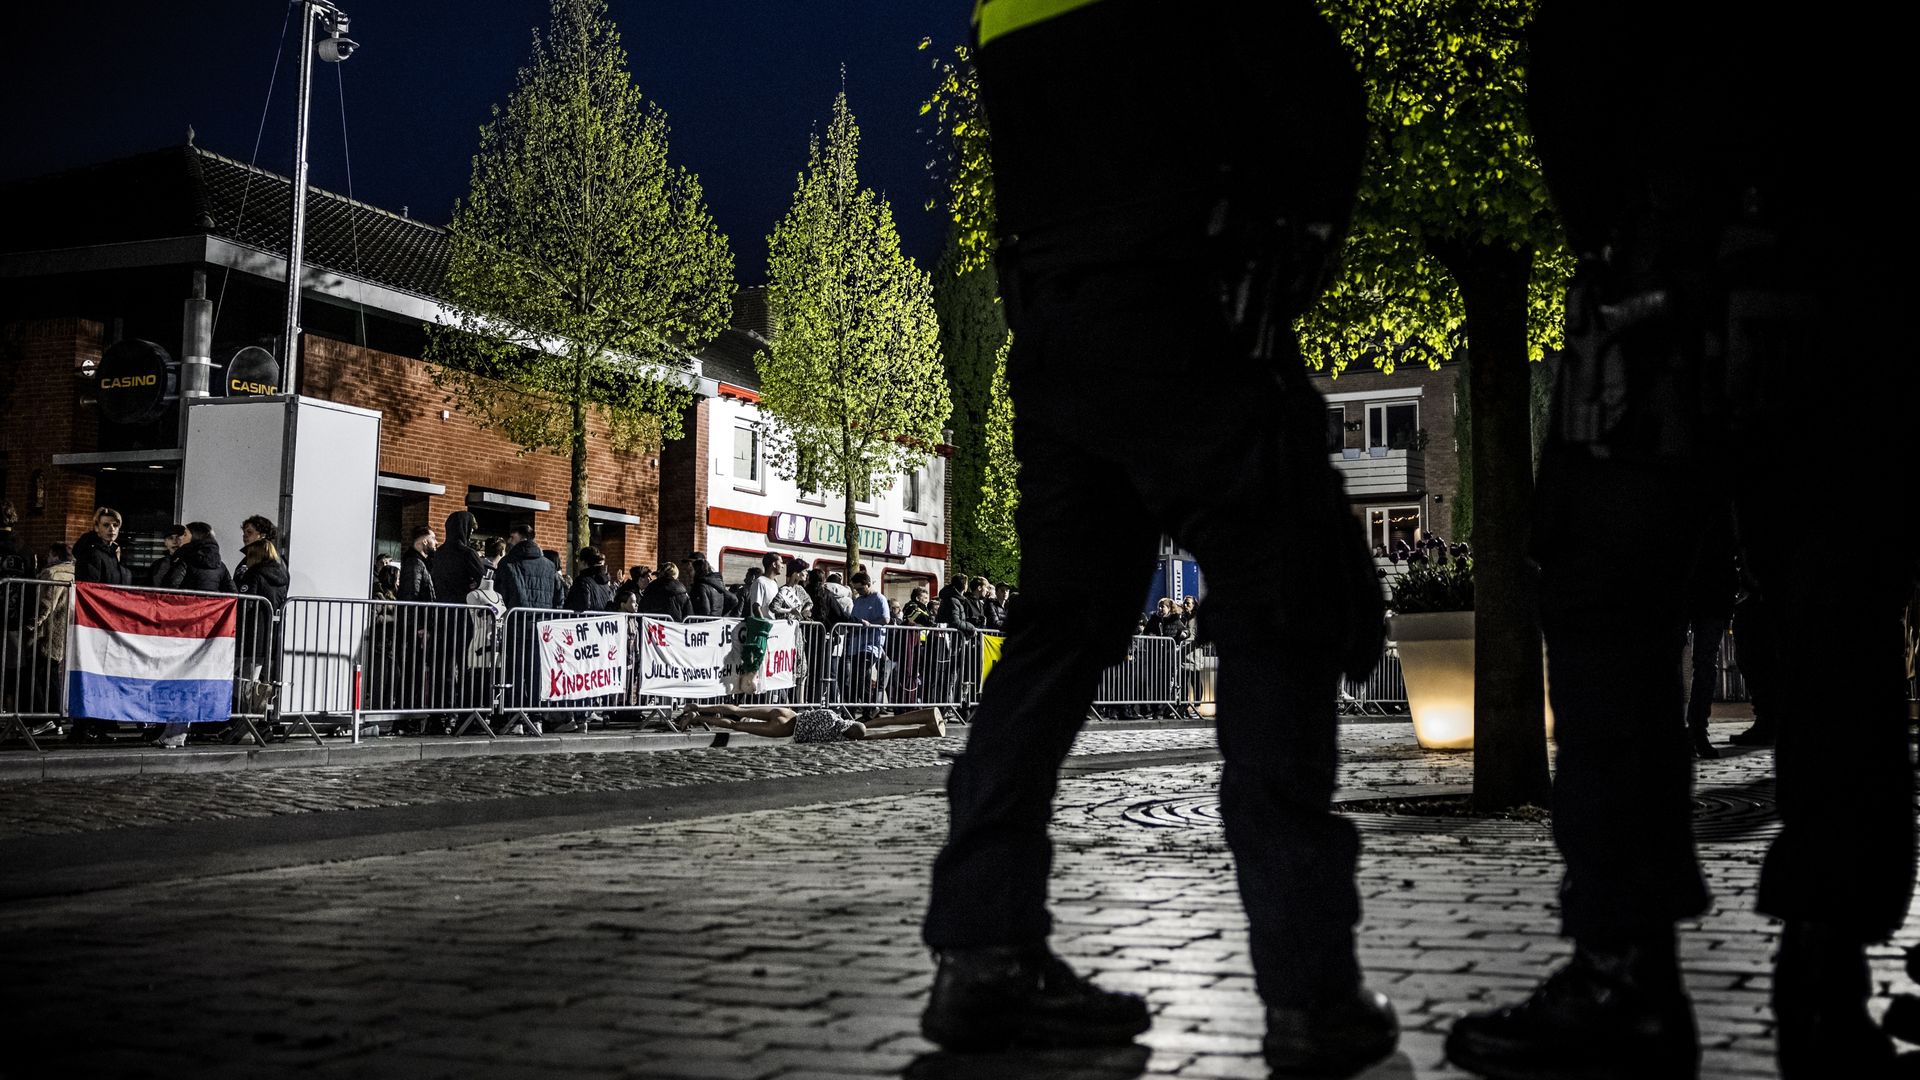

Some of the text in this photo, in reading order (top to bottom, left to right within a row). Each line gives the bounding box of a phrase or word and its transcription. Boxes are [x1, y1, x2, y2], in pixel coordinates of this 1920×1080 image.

[101, 374, 157, 389] CASINO
[575, 620, 619, 641] AF VAN
[684, 629, 710, 647] LAAT
[574, 643, 600, 660] ONZE
